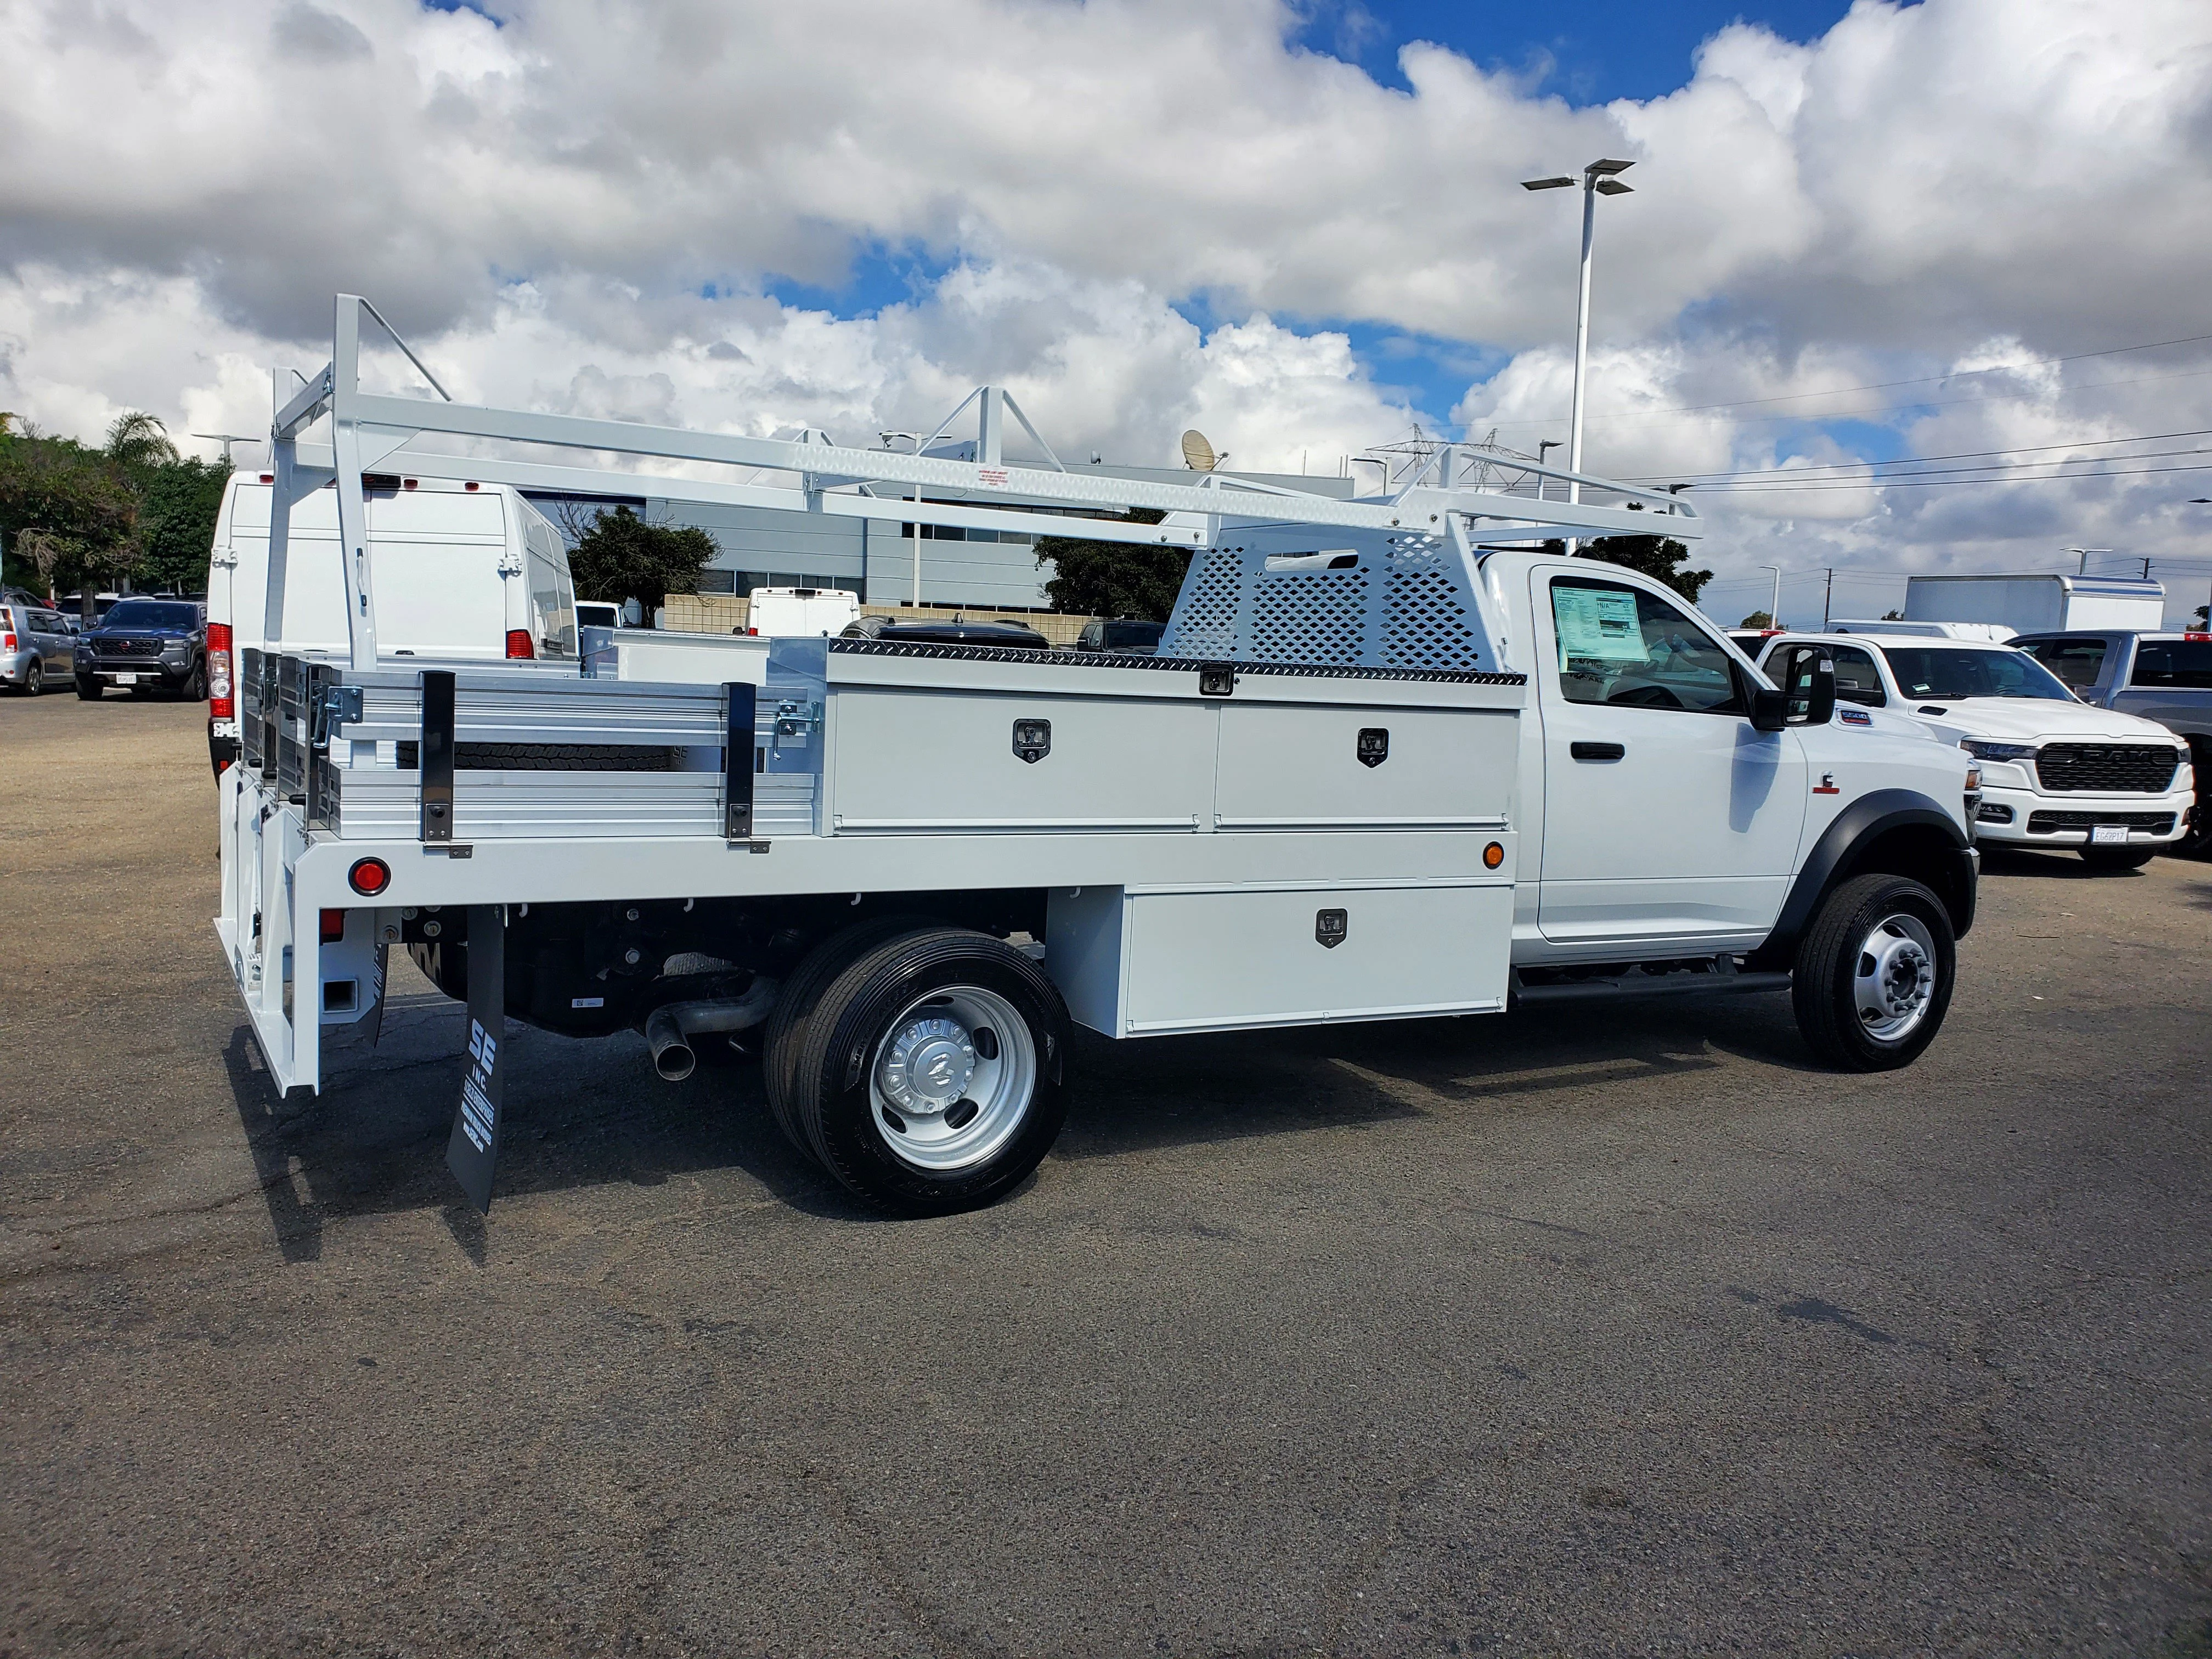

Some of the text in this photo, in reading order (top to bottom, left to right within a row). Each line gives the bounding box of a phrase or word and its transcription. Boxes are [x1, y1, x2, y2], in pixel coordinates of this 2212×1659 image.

[2083, 749, 2151, 761] RAM
[2096, 832, 2125, 840] EG62P17
[469, 1018, 496, 1076] SE
[472, 1063, 487, 1092] INC.
[473, 1090, 494, 1125] ENTERPRISES
